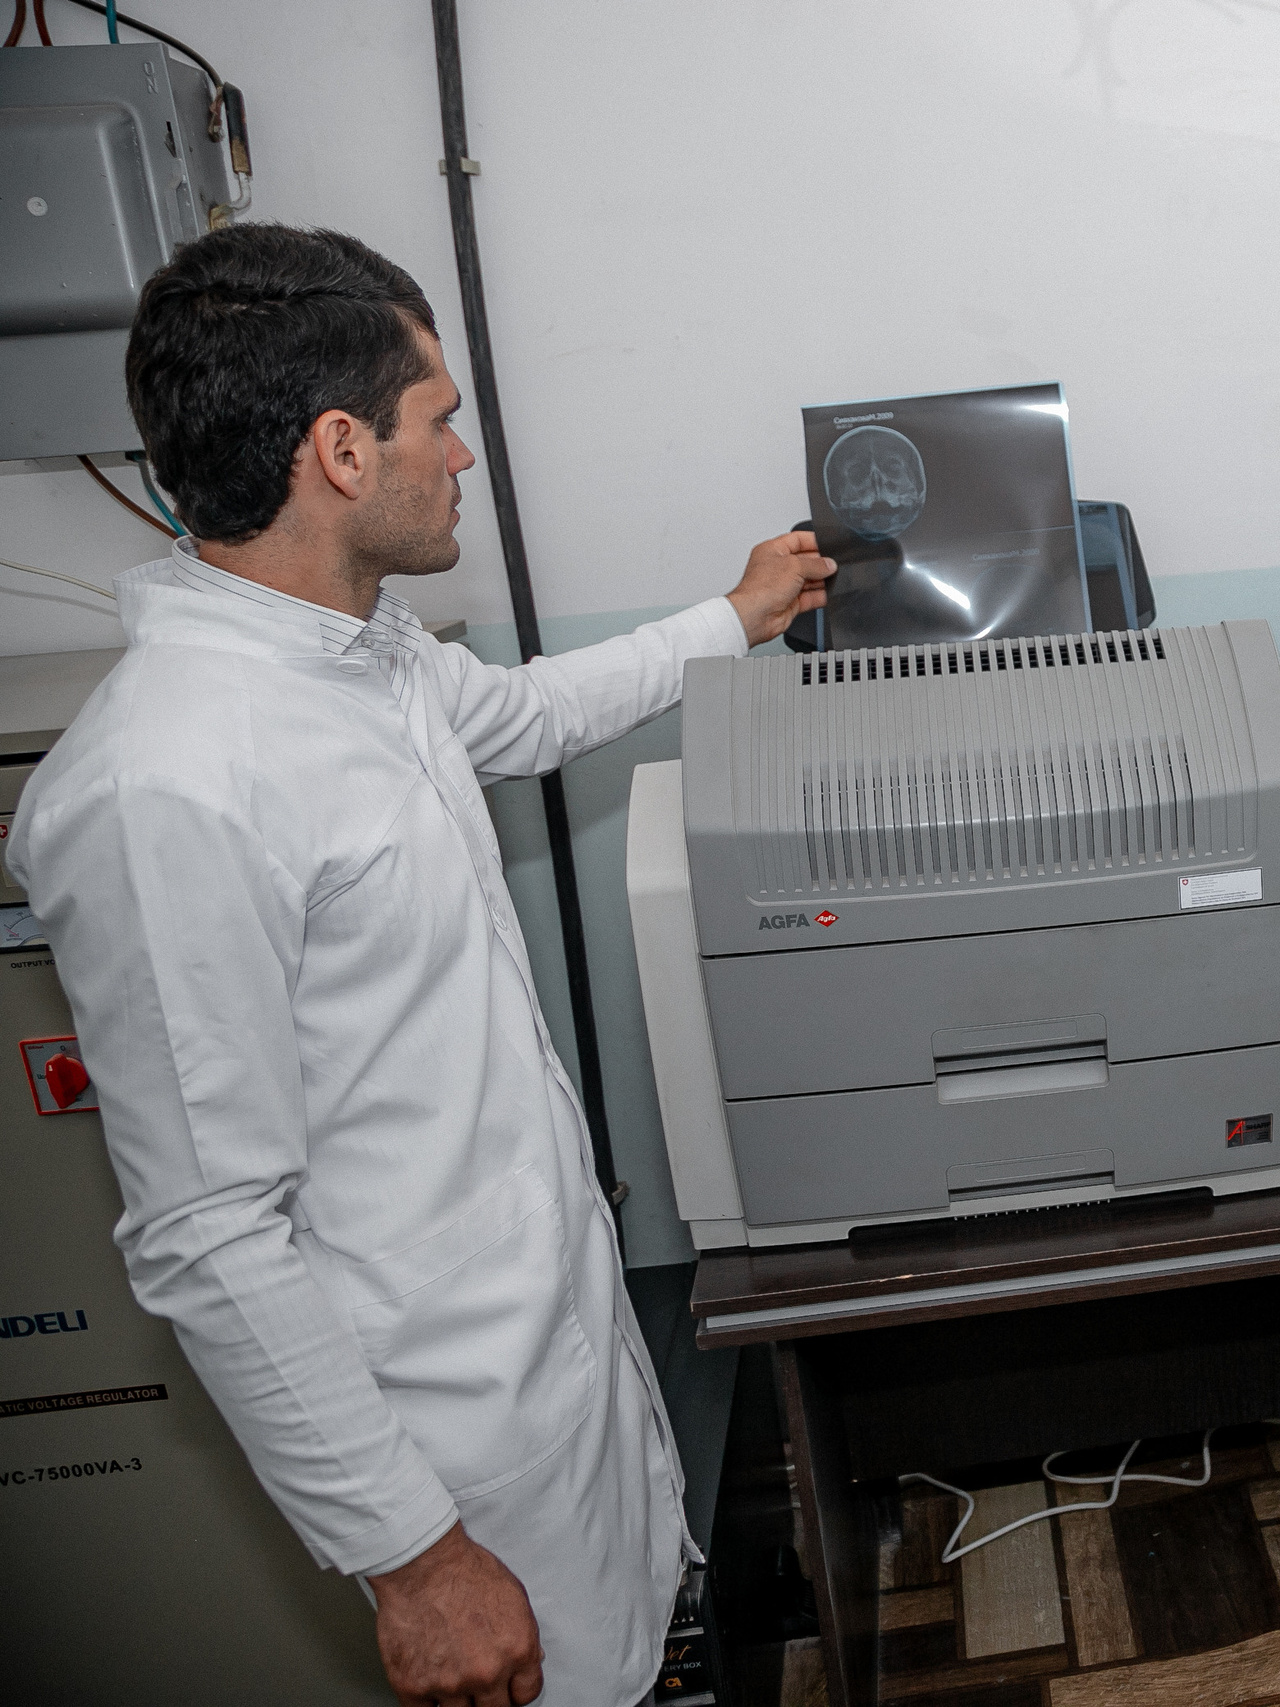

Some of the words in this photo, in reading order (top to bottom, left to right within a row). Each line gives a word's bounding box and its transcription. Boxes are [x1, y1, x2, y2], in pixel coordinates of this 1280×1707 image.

[758, 912, 811, 931] AGFA
[817, 914, 836, 923] Agfa
[10, 960, 43, 969] OUTPUT
[28, 1395, 85, 1411] VOLTAGE
[86, 1388, 159, 1404] REGULATOR
[682, 1661, 702, 1670] BOX
